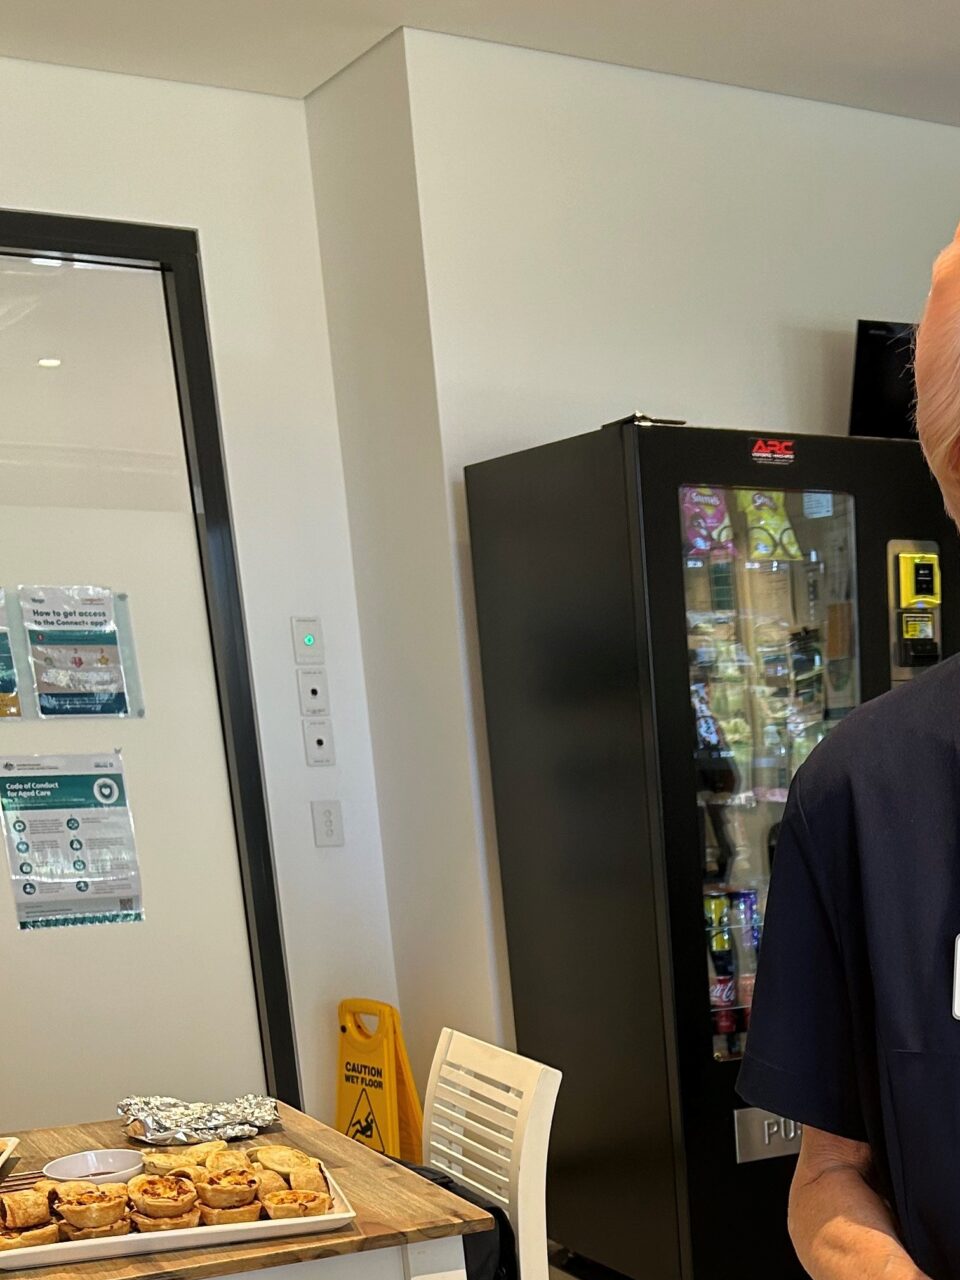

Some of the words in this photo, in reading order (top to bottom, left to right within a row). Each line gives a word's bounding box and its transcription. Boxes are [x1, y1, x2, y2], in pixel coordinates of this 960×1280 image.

[752, 438, 794, 455] ARC
[32, 609, 51, 617] How
[63, 610, 77, 618] get
[5, 782, 23, 790] Code
[24, 782, 31, 790] of
[32, 781, 59, 790] Conduct
[7, 790, 18, 798] for
[36, 789, 51, 797] Care
[345, 1061, 383, 1078] CAUTION
[344, 1074, 359, 1085] WET
[360, 1075, 383, 1091] FLOOR
